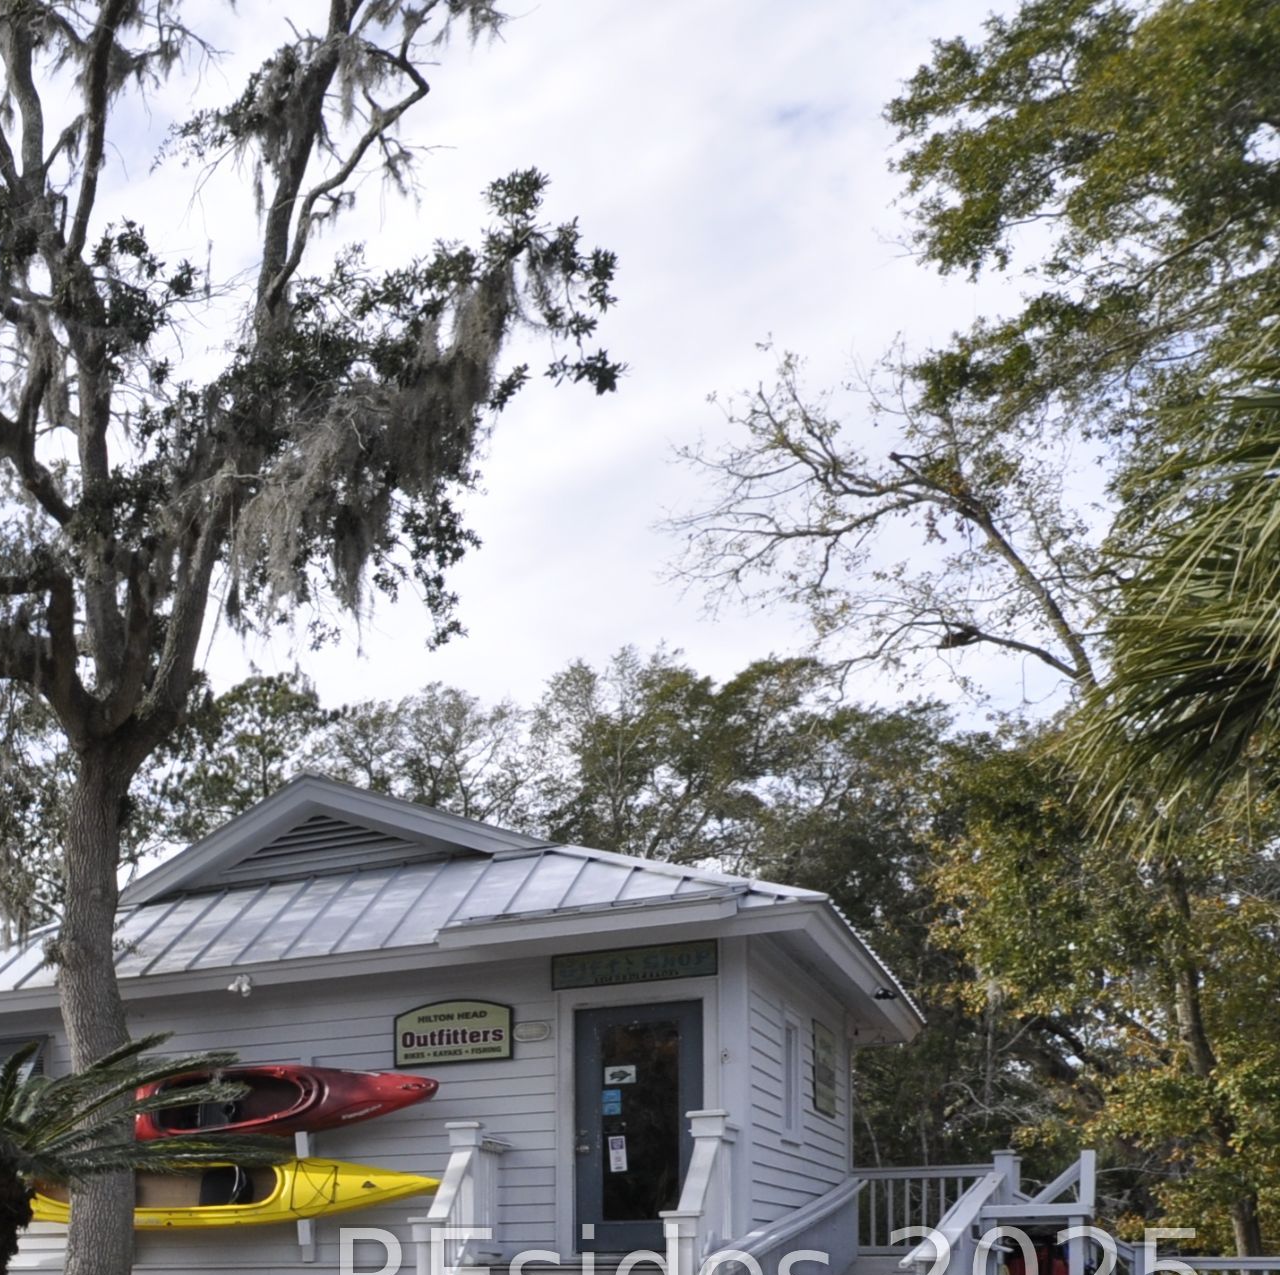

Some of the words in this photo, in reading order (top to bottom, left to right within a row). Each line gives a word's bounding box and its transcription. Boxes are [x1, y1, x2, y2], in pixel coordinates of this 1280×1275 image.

[417, 1013, 455, 1024] HILTON
[457, 1010, 488, 1020] HEAD
[401, 1027, 504, 1049] Outfitters
[471, 1046, 502, 1055] FISHING
